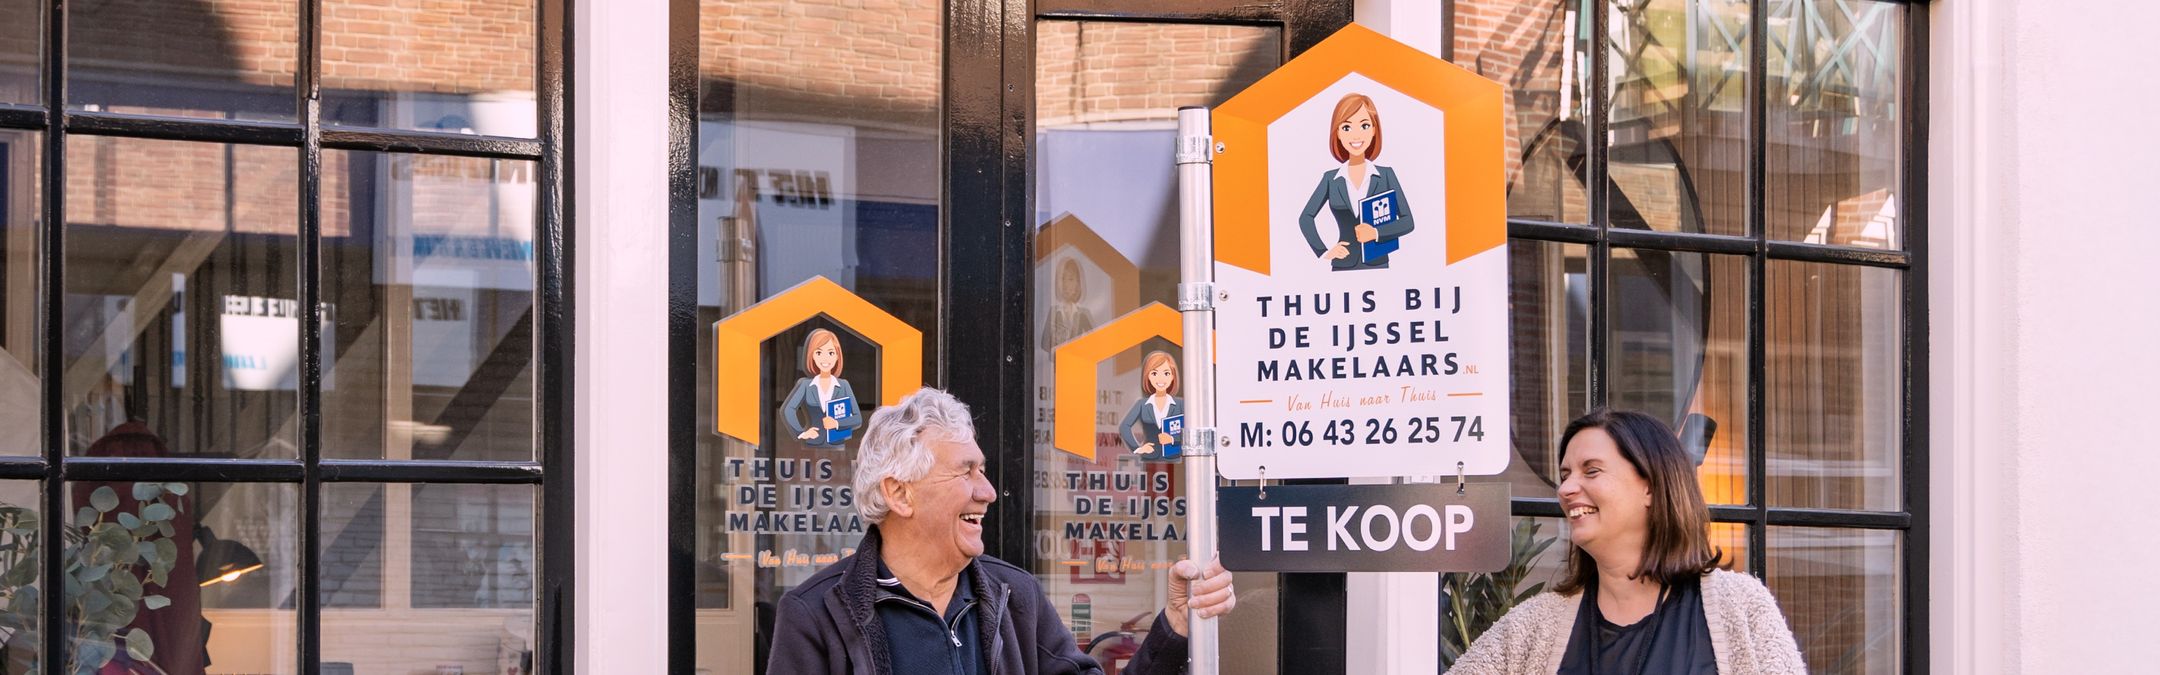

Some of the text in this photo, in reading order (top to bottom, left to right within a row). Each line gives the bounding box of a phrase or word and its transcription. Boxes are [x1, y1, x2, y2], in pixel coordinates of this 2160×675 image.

[1256, 286, 1461, 318] THUIS BIJ
[1269, 320, 1449, 352] DE IJSSEL
[1286, 385, 1437, 412] Van Huis naar Thuis
[1240, 415, 1485, 448] M: 06 43 26 25 74
[731, 460, 832, 479] THUIS
[1066, 473, 1168, 492] THUIS
[740, 486, 851, 510] DE IJSS
[1077, 498, 1186, 520] DE IJSS
[730, 513, 862, 533] MAKELAA
[1251, 503, 1474, 552] TE KOOP
